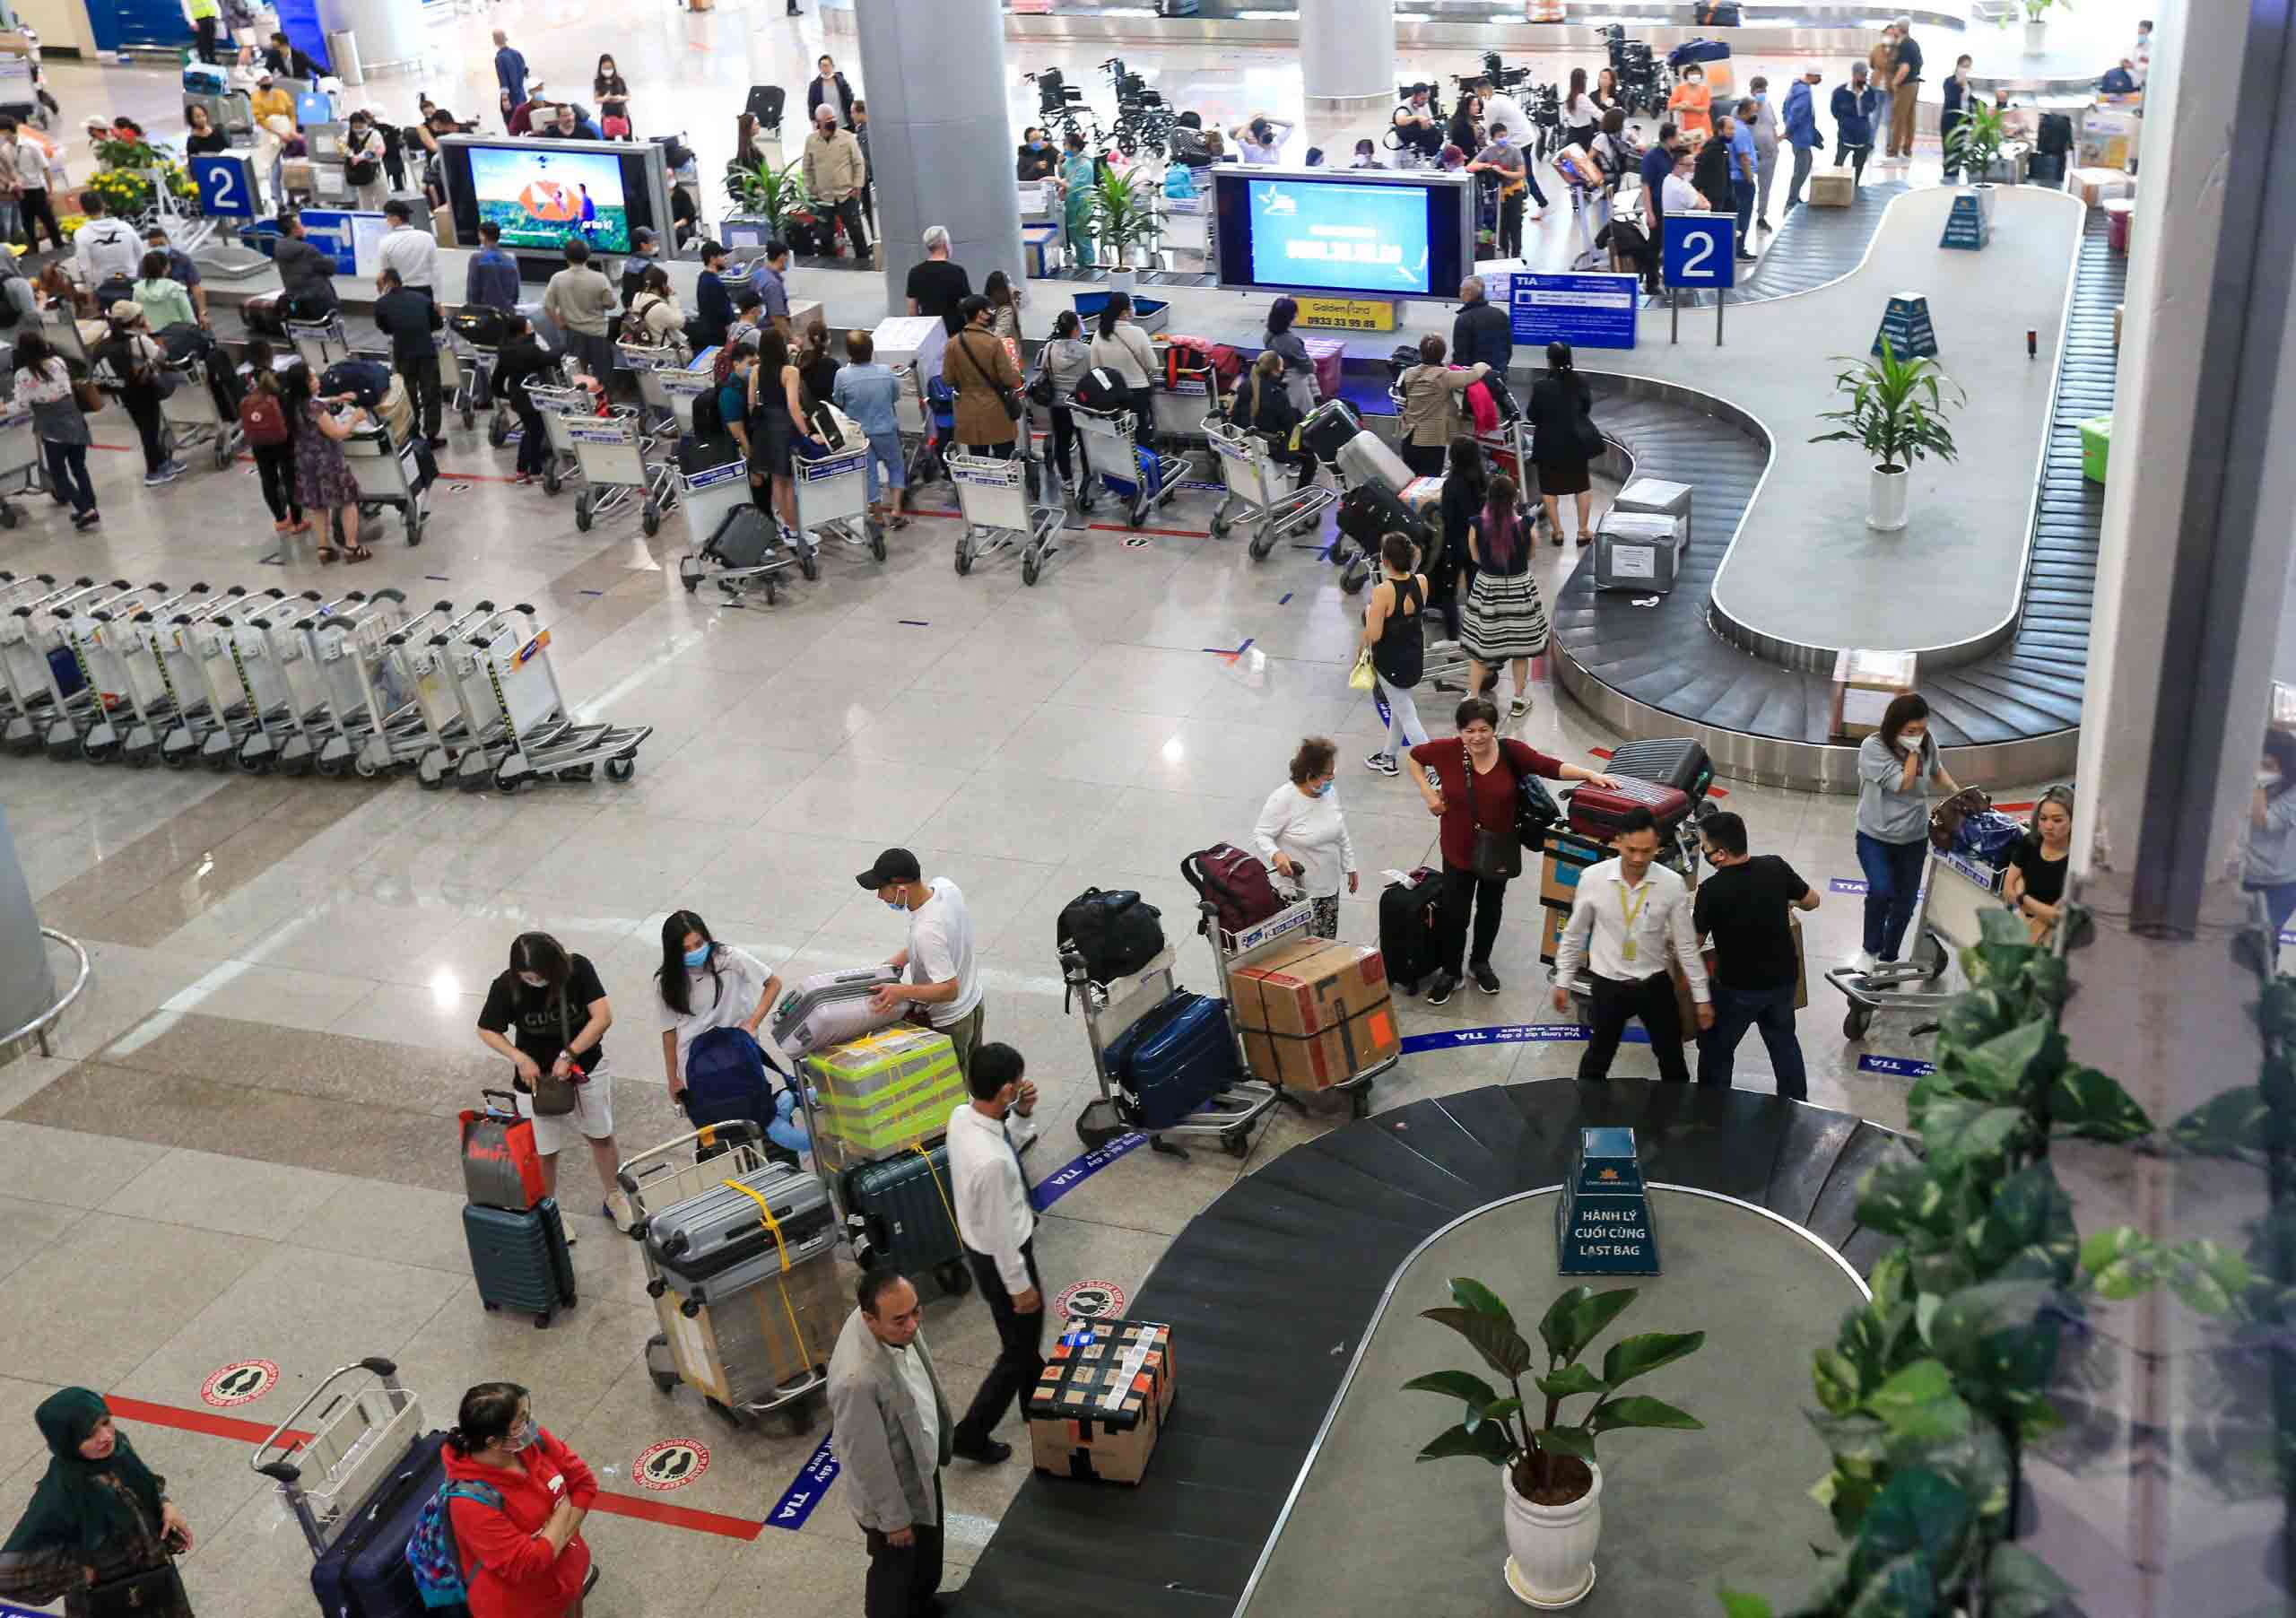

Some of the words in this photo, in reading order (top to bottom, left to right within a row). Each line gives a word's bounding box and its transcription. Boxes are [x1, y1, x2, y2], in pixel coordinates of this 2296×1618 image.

[209, 166, 239, 208] 2
[1682, 231, 1715, 276] 2
[1516, 276, 1538, 285] TIA
[1836, 882, 1866, 891] TIA
[1454, 1032, 1488, 1040] TIA
[1868, 1057, 1901, 1070] TIA
[1050, 1169, 1083, 1184] TIA
[1583, 1209, 1620, 1221] HÀNH
[1622, 1209, 1637, 1221] LÝ
[1575, 1225, 1606, 1239] CUỐI
[1608, 1226, 1646, 1239] CÙNG
[1580, 1246, 1611, 1256] LAST
[1613, 1246, 1639, 1256] BAG
[807, 1451, 830, 1472] here
[778, 1492, 811, 1518] TIA
